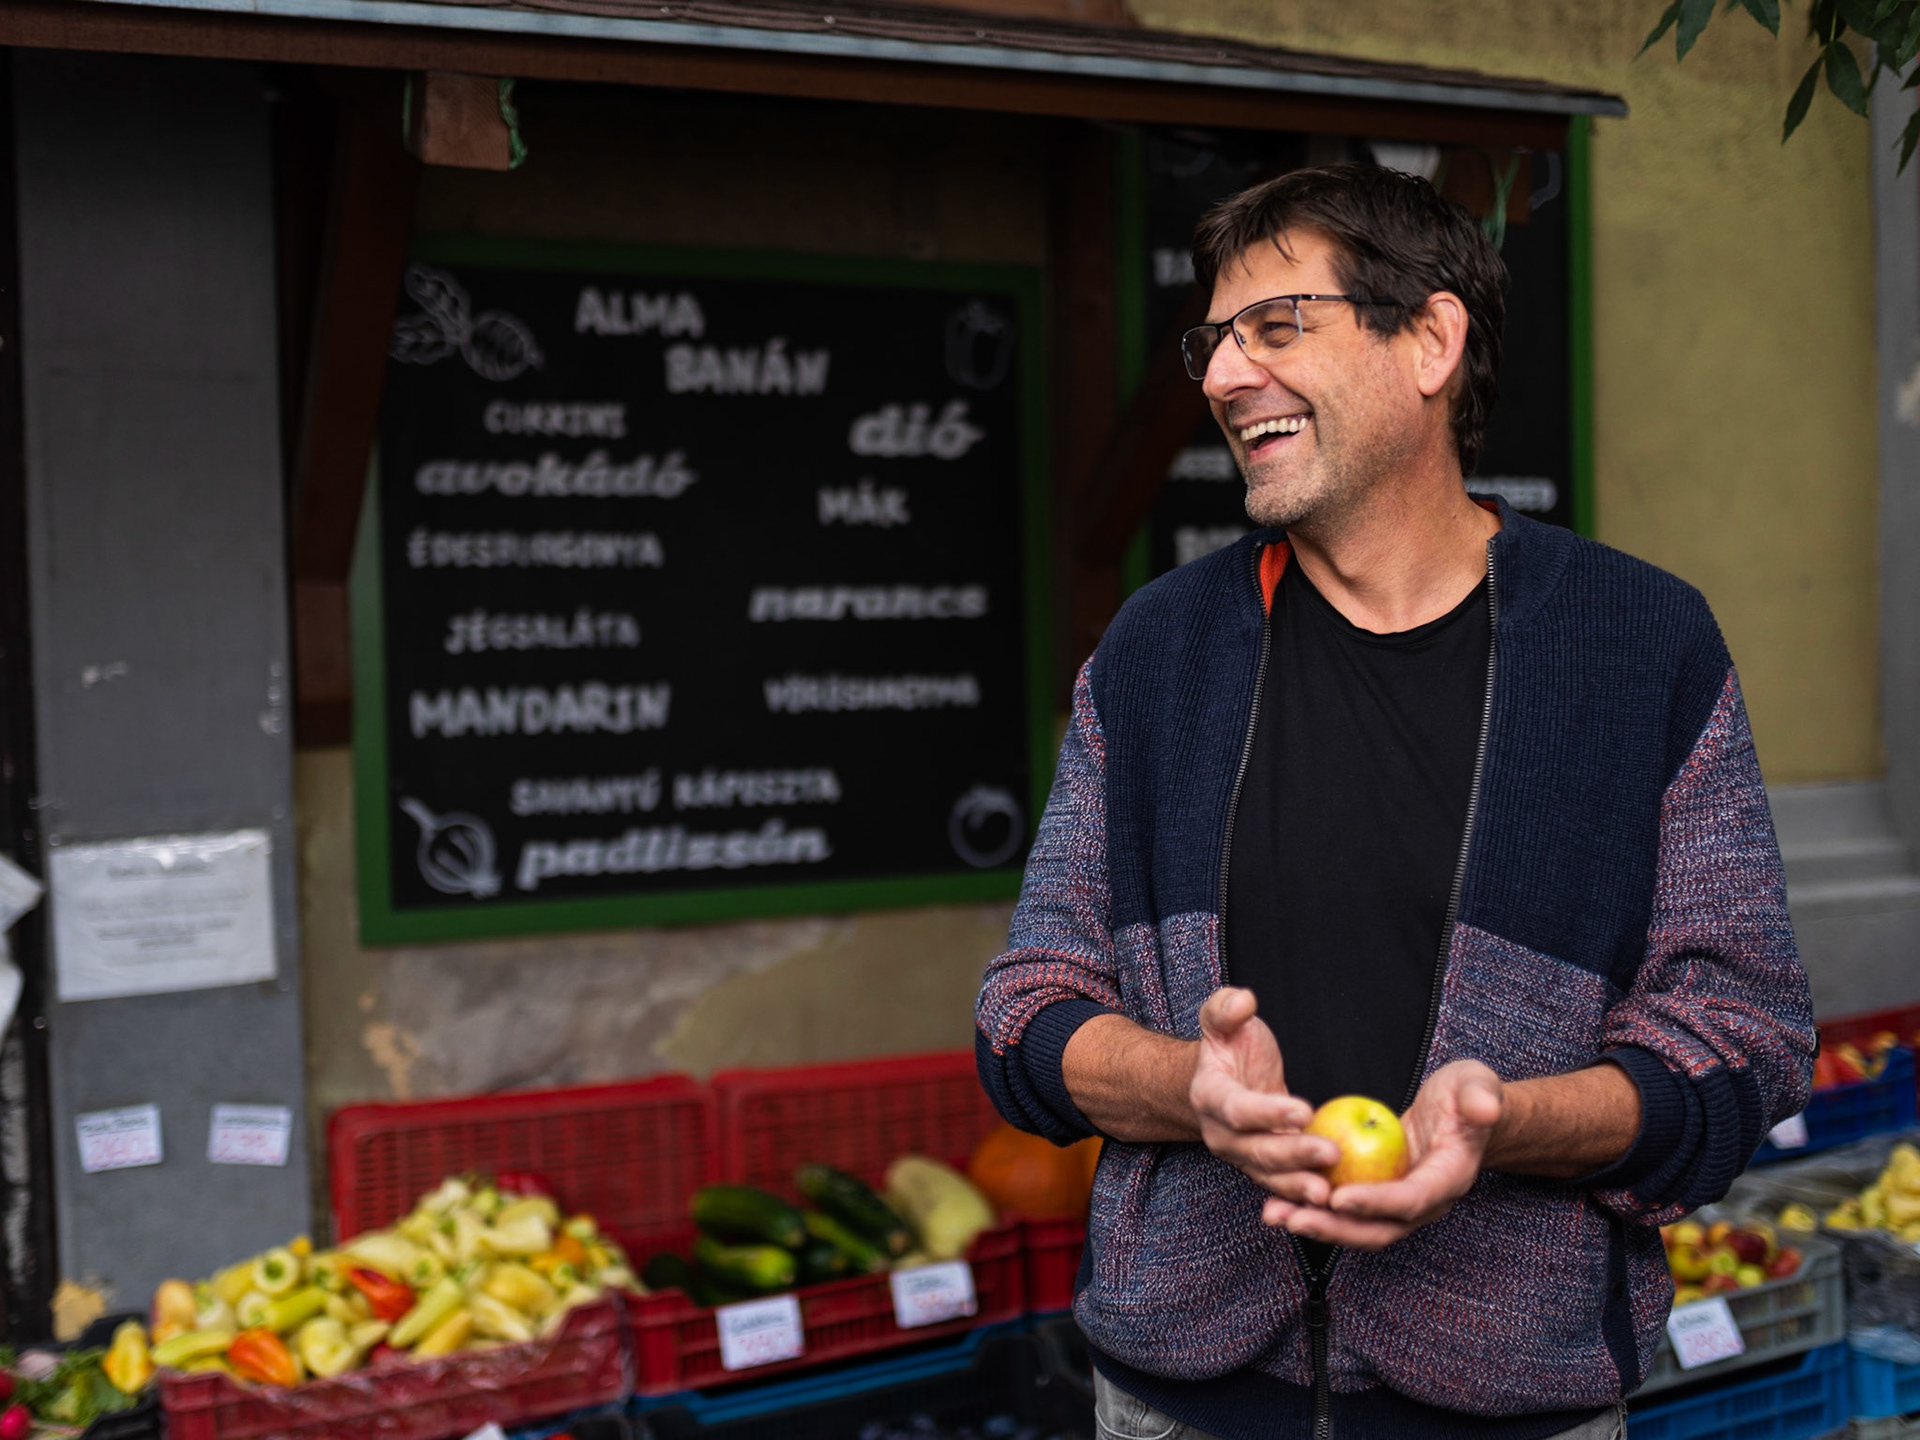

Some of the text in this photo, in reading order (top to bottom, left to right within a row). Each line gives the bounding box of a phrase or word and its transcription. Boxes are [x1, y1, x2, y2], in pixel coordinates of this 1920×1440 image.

[575, 287, 705, 338] ALMA
[662, 340, 830, 395] BANÁN
[849, 402, 985, 460] dió
[416, 451, 696, 499] avokádó
[818, 482, 909, 526] MÁK
[749, 586, 988, 622] narancs
[445, 608, 640, 654] JÉGSALÁTA
[410, 683, 671, 738] MANDARIN
[516, 819, 832, 891] padlizsán
